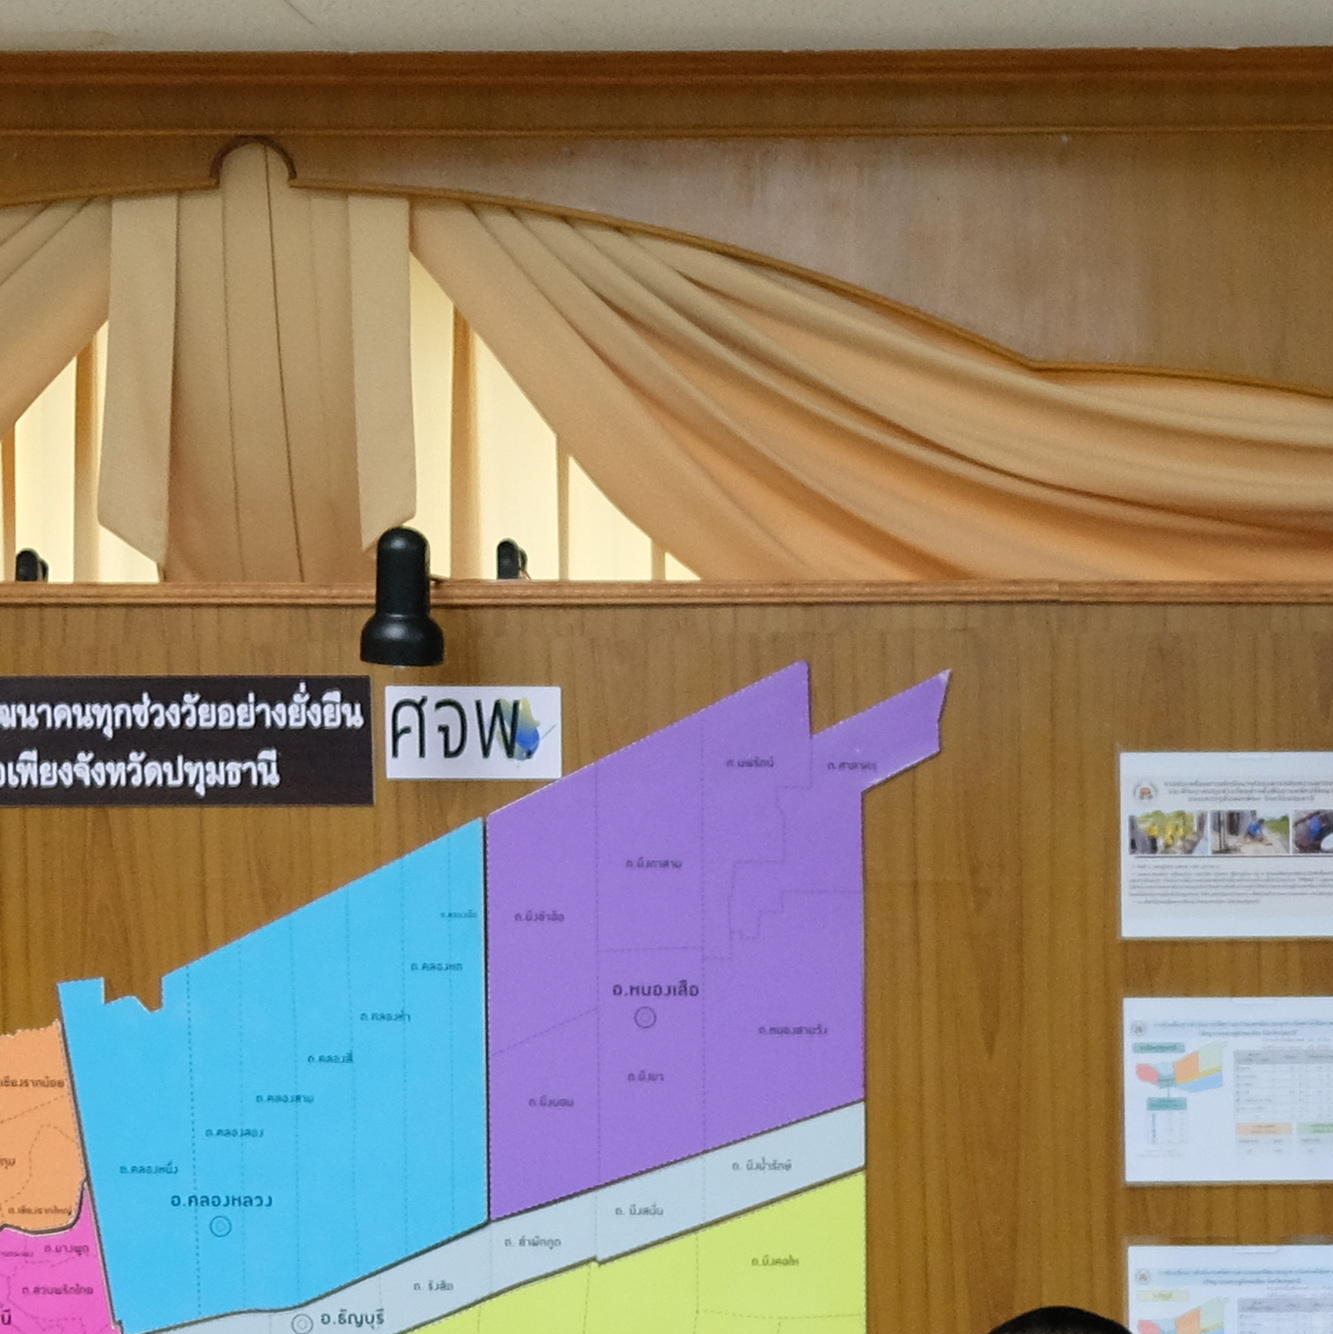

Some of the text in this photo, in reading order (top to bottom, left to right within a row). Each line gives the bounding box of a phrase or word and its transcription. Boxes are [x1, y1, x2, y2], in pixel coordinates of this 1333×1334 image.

[0, 748, 281, 798] เพียงจังหวัดปทุมธานี
[612, 979, 700, 997] อ.หนองเสือ
[170, 1194, 273, 1208] อ.คลองหลวง
[320, 1308, 385, 1330] อ.ธัญบุรี
